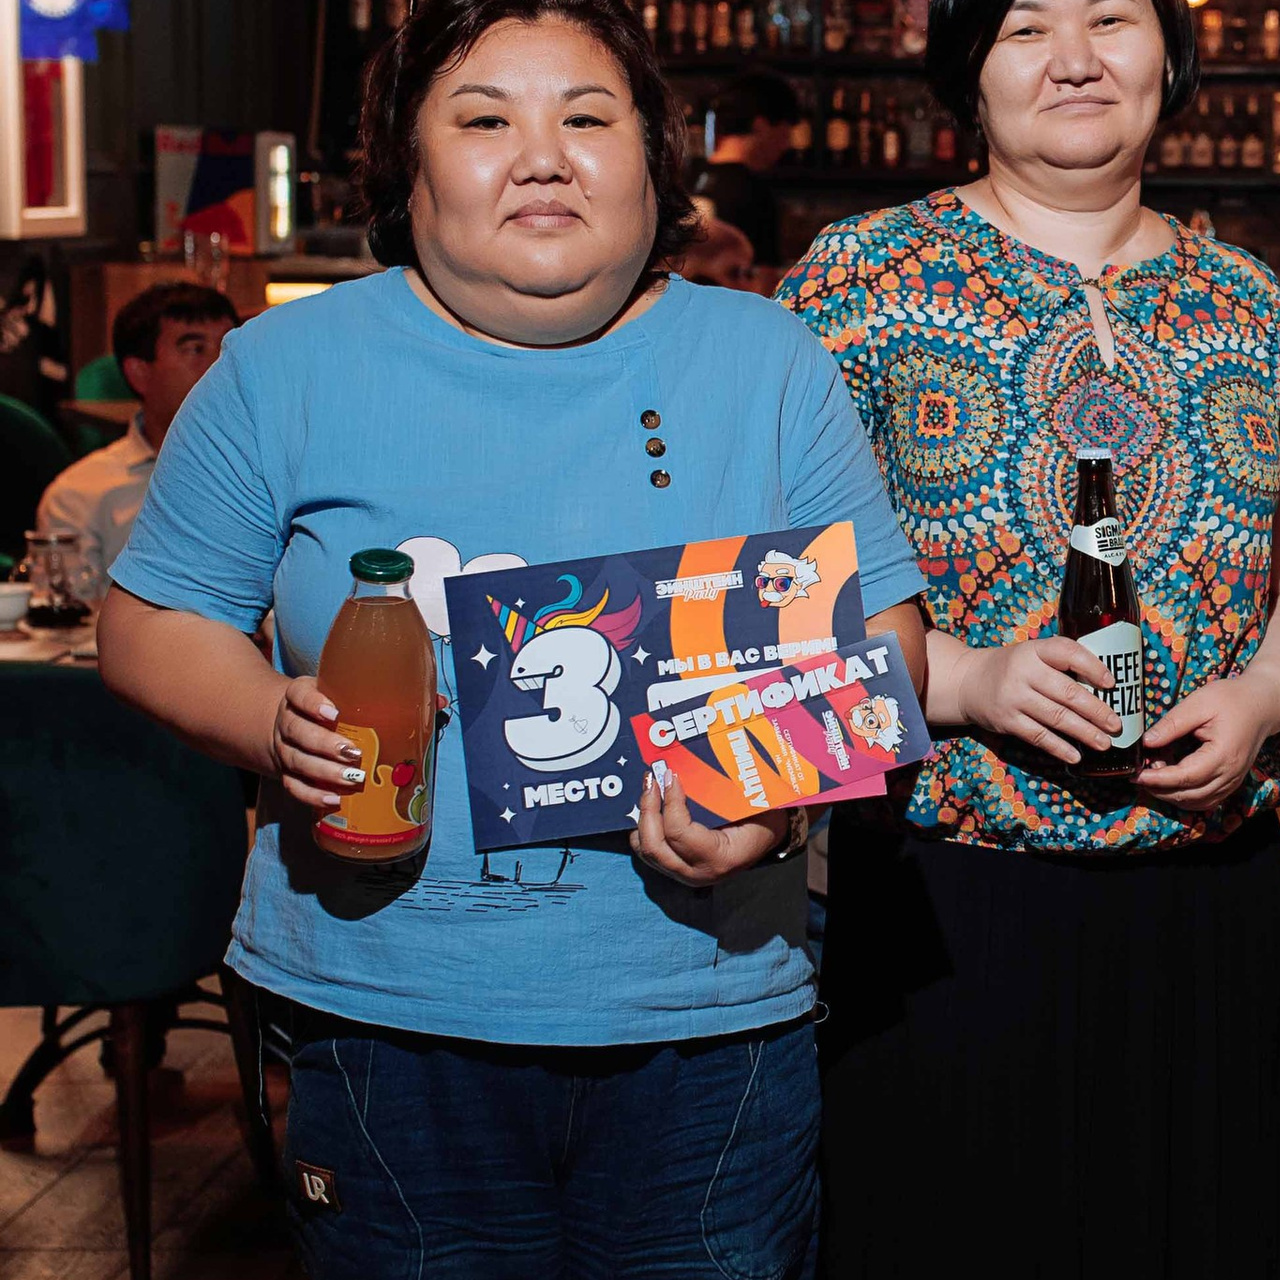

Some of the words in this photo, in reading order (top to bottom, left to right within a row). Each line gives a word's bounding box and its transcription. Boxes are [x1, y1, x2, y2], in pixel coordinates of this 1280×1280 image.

[684, 587, 720, 602] Party
[658, 655, 694, 676] МЫ
[697, 652, 712, 669] В
[715, 647, 760, 667] ВАС
[763, 637, 838, 661] ВЕРИМ!
[504, 626, 622, 772] 3
[649, 646, 889, 748] СЕРТИФИКАТ
[524, 775, 623, 809] МЕСТО
[727, 727, 770, 808] ПИЦЦУ
